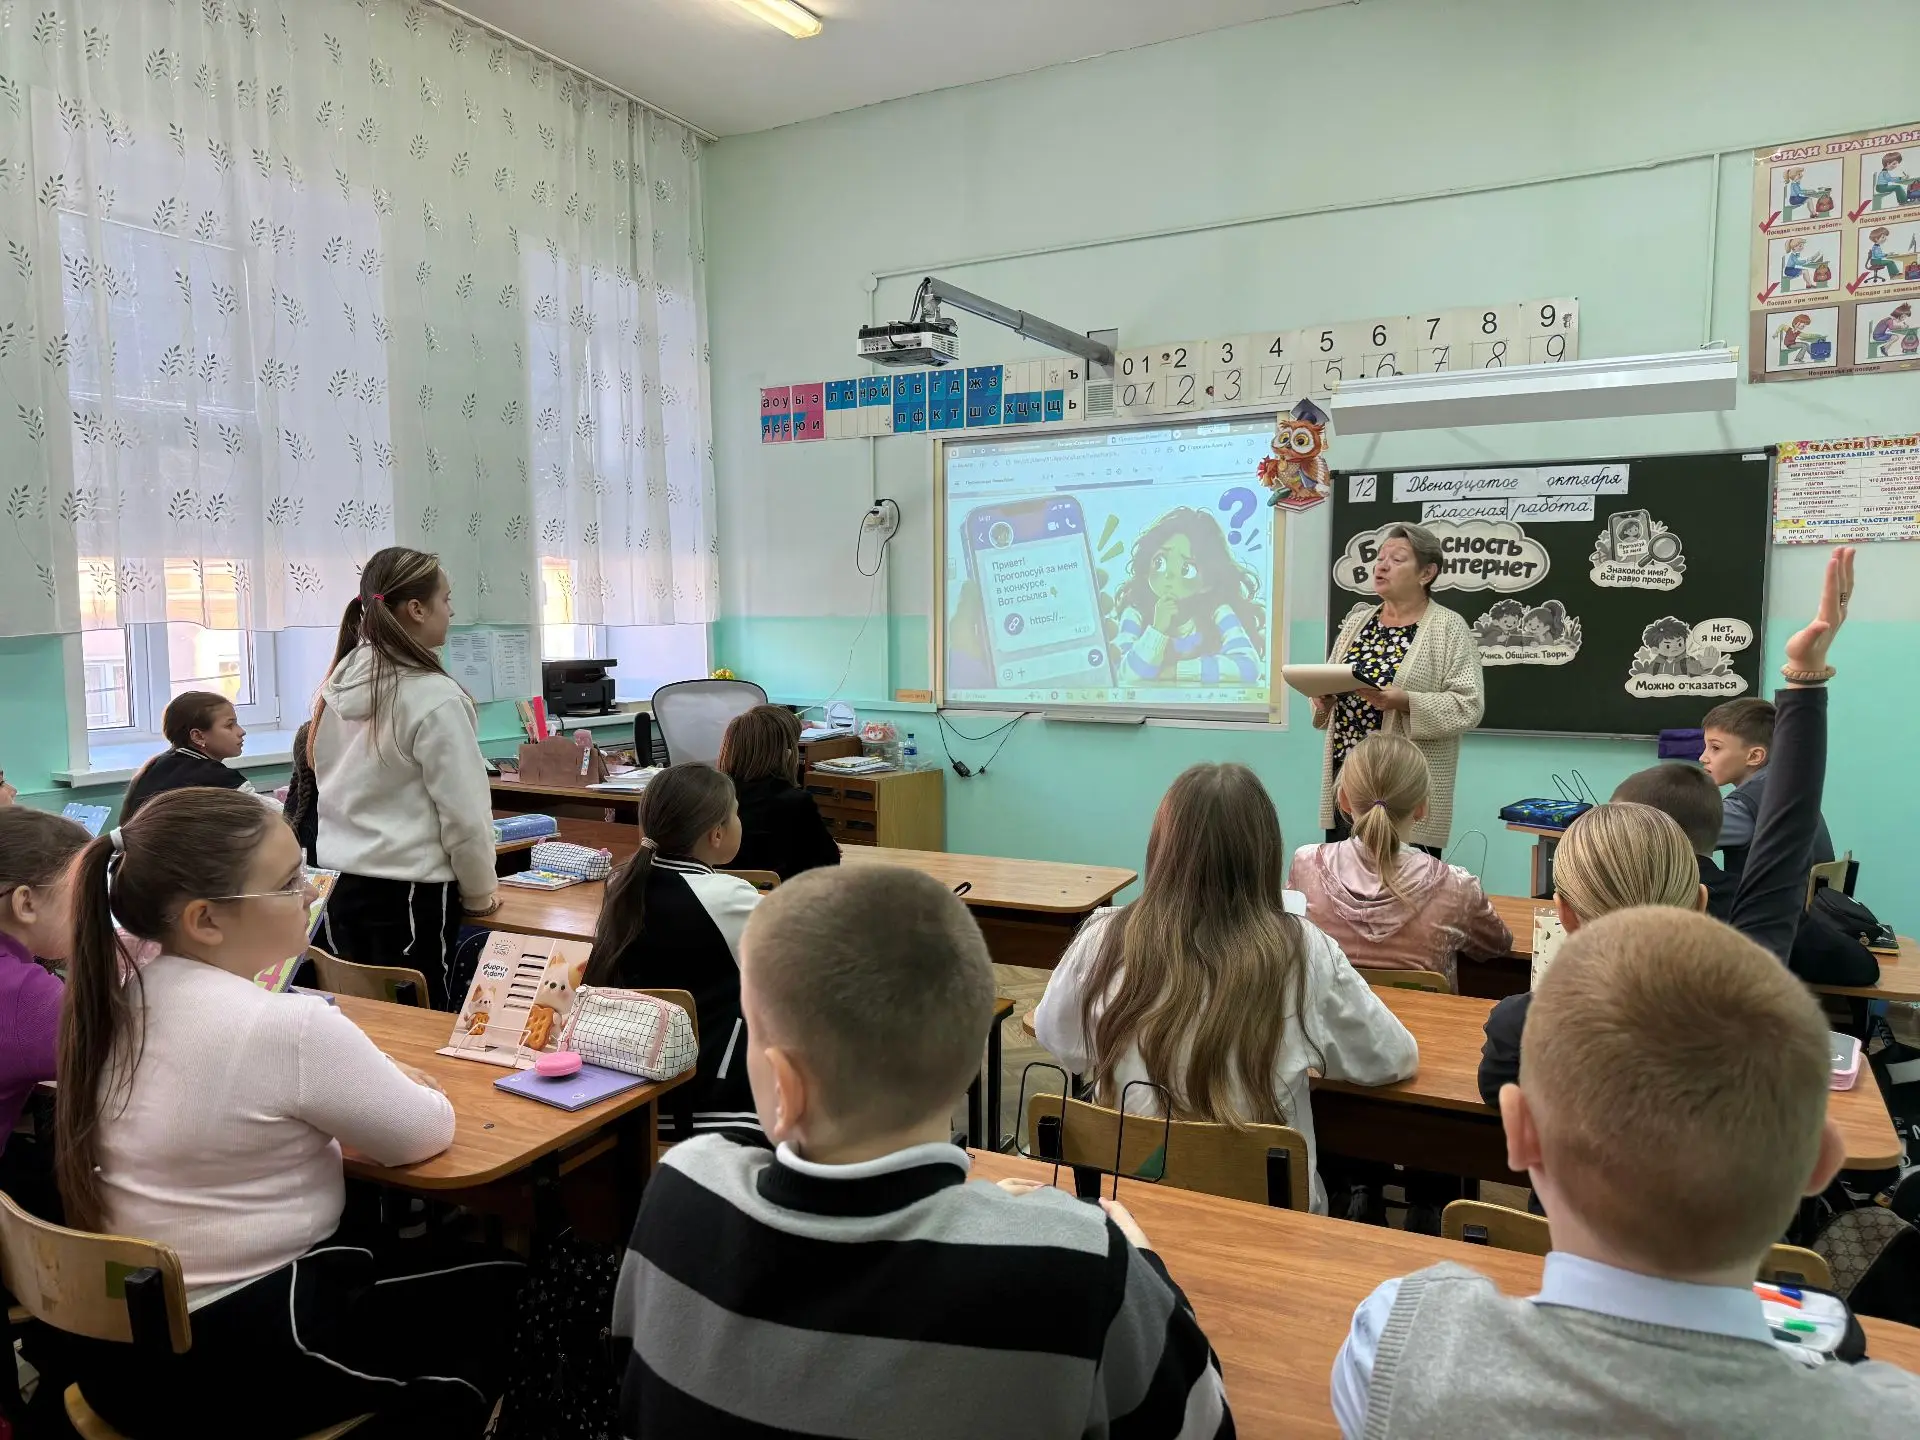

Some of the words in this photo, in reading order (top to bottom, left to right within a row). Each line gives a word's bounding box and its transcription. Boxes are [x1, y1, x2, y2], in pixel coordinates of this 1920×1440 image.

[1770, 146, 1820, 161] СИДИ
[1123, 358, 1133, 375] 0
[1142, 356, 1149, 373] 1
[1174, 348, 1187, 368] 2
[1222, 343, 1233, 363] 3
[1269, 337, 1283, 357] 4
[1320, 331, 1333, 352] 5
[1372, 325, 1387, 346] 6
[1427, 318, 1441, 340] 7
[1482, 312, 1497, 334] 8
[1540, 305, 1556, 327] 9
[1123, 385, 1136, 406] 0
[1145, 382, 1155, 404] 1
[1177, 375, 1195, 405] 2
[1224, 370, 1241, 400] 3
[1274, 365, 1291, 396] 4
[1432, 346, 1449, 372] 7
[1486, 341, 1506, 368] 8
[1547, 334, 1565, 362] 9
[763, 399, 770, 408] а
[773, 398, 779, 407] о
[782, 397, 789, 408] у
[795, 396, 804, 405] ы
[812, 394, 819, 403] э
[829, 392, 837, 402] л
[869, 388, 877, 400] р
[898, 380, 906, 394] б
[914, 384, 922, 394] в
[951, 381, 960, 393] д
[969, 379, 981, 389] ж
[989, 377, 997, 387] з
[1068, 370, 1079, 380] ъ
[763, 425, 770, 433] я
[773, 424, 780, 432] е
[795, 422, 805, 431] ю
[812, 421, 820, 430] и
[898, 412, 906, 423] п
[913, 409, 924, 424] ф
[933, 410, 940, 420] к
[951, 409, 959, 419] т
[970, 407, 981, 417] ш
[989, 405, 997, 415] с
[1006, 404, 1014, 414] х
[1018, 403, 1028, 415] ц
[1031, 402, 1040, 412] ч
[1047, 400, 1060, 413] щ
[1068, 400, 1077, 409] ь
[1810, 441, 1865, 452] ЧАСТИ
[1872, 437, 1917, 448] РЕЧИ
[1794, 451, 1875, 461] САМОСТОЯТЕЛЬНЫЕ
[1354, 477, 1373, 498] 12
[1406, 475, 1519, 497] Двенадцатое
[1546, 466, 1622, 492] октября
[1424, 505, 1507, 520] Классная
[992, 557, 1026, 572] Привет!
[994, 566, 1044, 582] Проголосуй
[1046, 565, 1056, 573] за
[1057, 561, 1078, 571] меня
[1439, 558, 1538, 579] нтернет
[1600, 573, 1615, 581] Всё
[1642, 576, 1676, 586] проверь
[1648, 568, 1669, 577] имя?
[1004, 579, 1048, 593] конкурсе.
[998, 597, 1015, 607] Вот
[1017, 591, 1048, 602] ссылка
[1712, 624, 1734, 634] Нет,
[1725, 633, 1747, 644] буду
[1480, 651, 1504, 660] Учись.
[1541, 650, 1569, 660] Твори.
[1635, 681, 1675, 690] Можно
